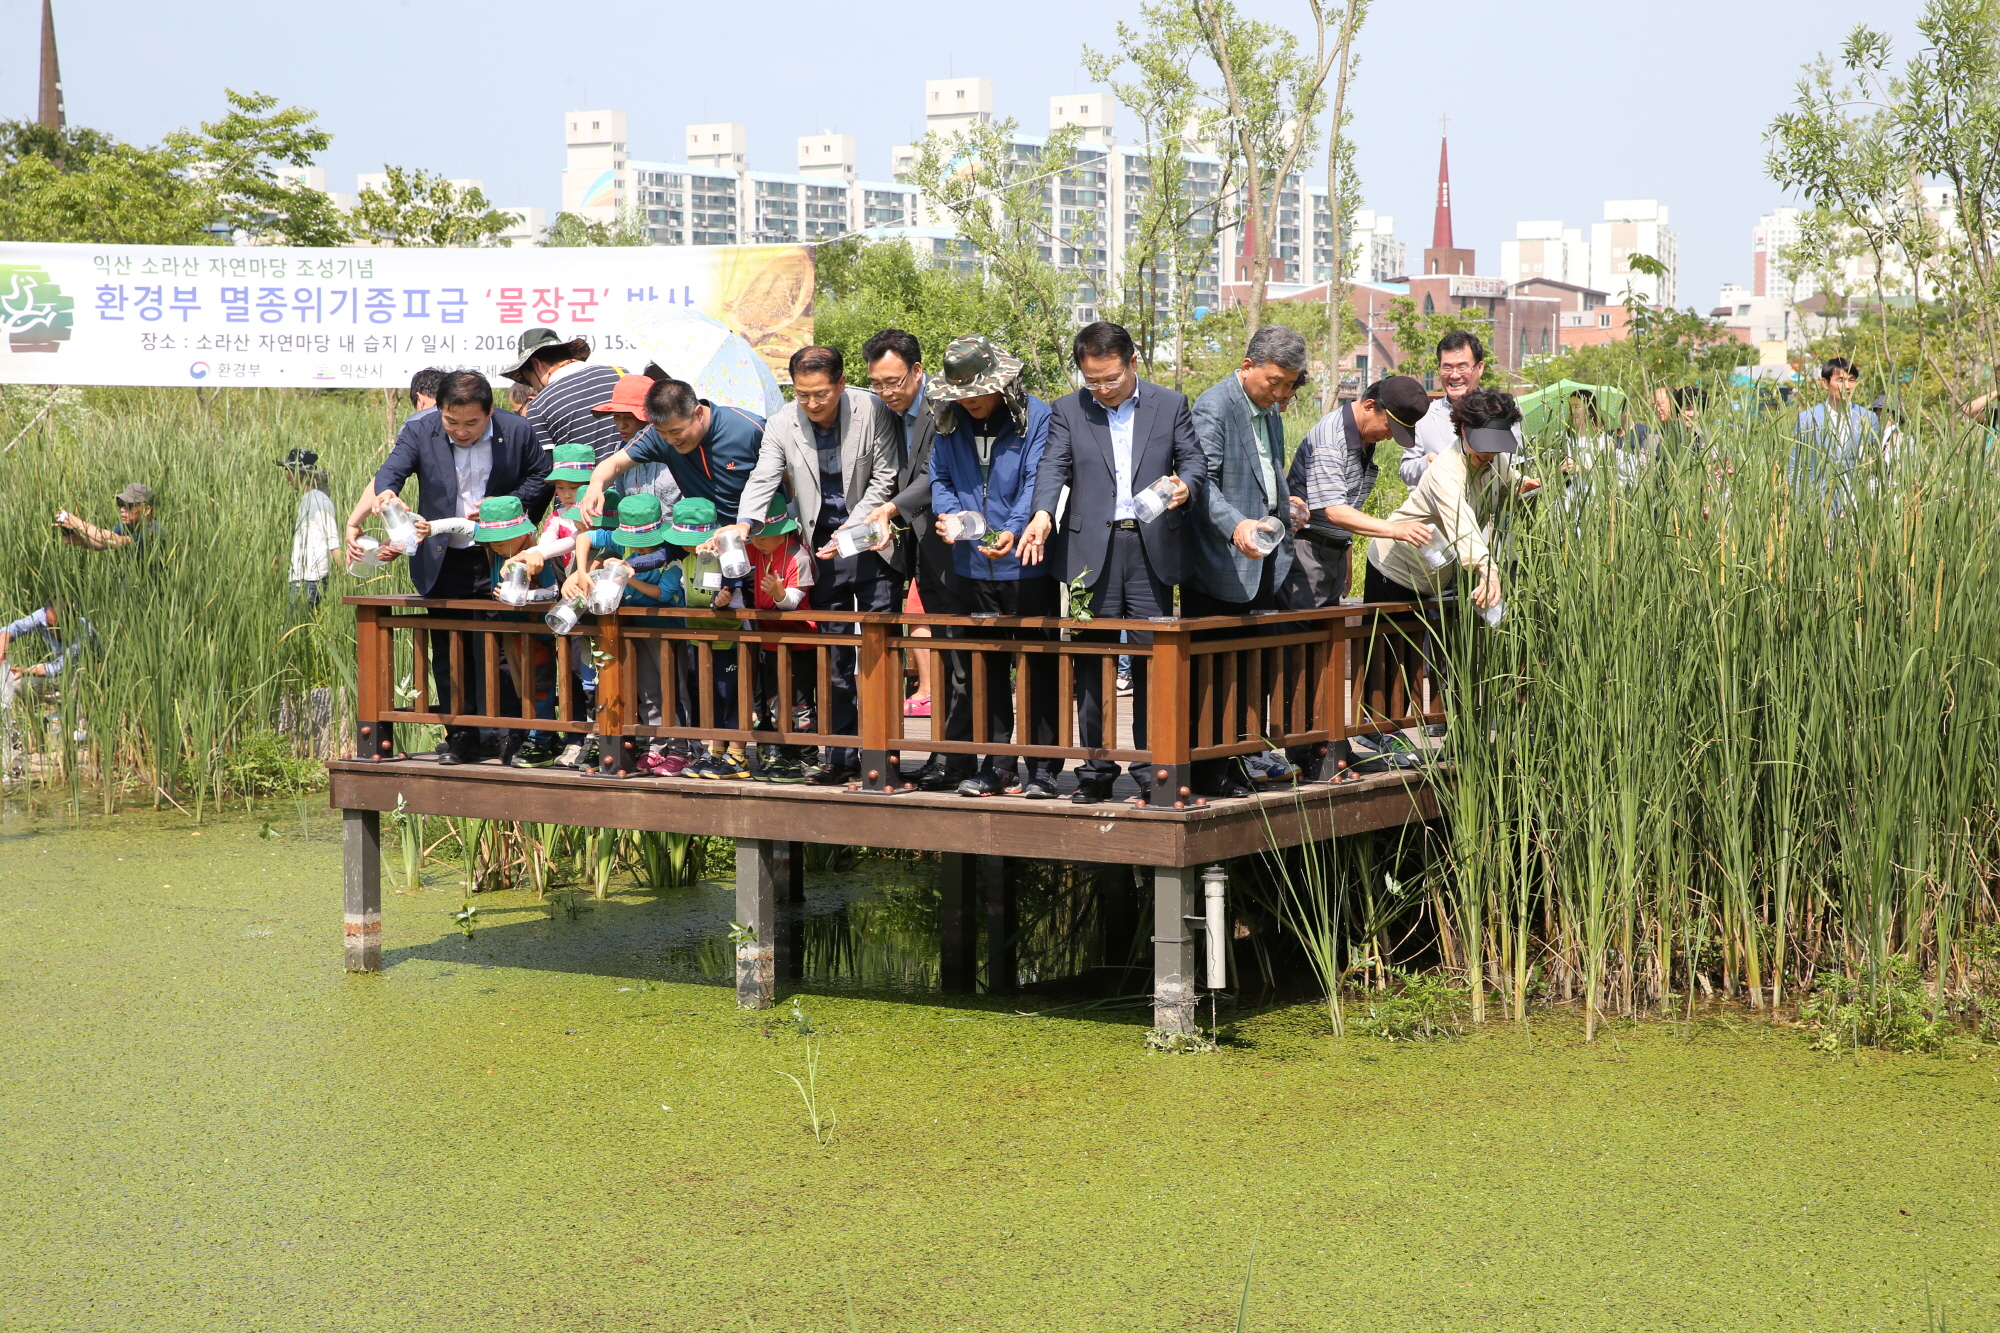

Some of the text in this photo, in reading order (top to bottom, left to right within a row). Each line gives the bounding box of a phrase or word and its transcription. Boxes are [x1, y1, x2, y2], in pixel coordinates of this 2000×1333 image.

[93, 255, 374, 279] 익산 소라산 자연마당 조성기념
[95, 284, 202, 322] 환경부
[486, 287, 610, 323] '물장군'
[141, 333, 176, 351] 장소
[196, 334, 250, 352] 소라산
[258, 334, 331, 353] 자연마당
[340, 335, 354, 353] 내
[363, 335, 398, 353] 습지
[421, 335, 455, 353] 일시
[217, 362, 383, 379] 환경부 익산시
